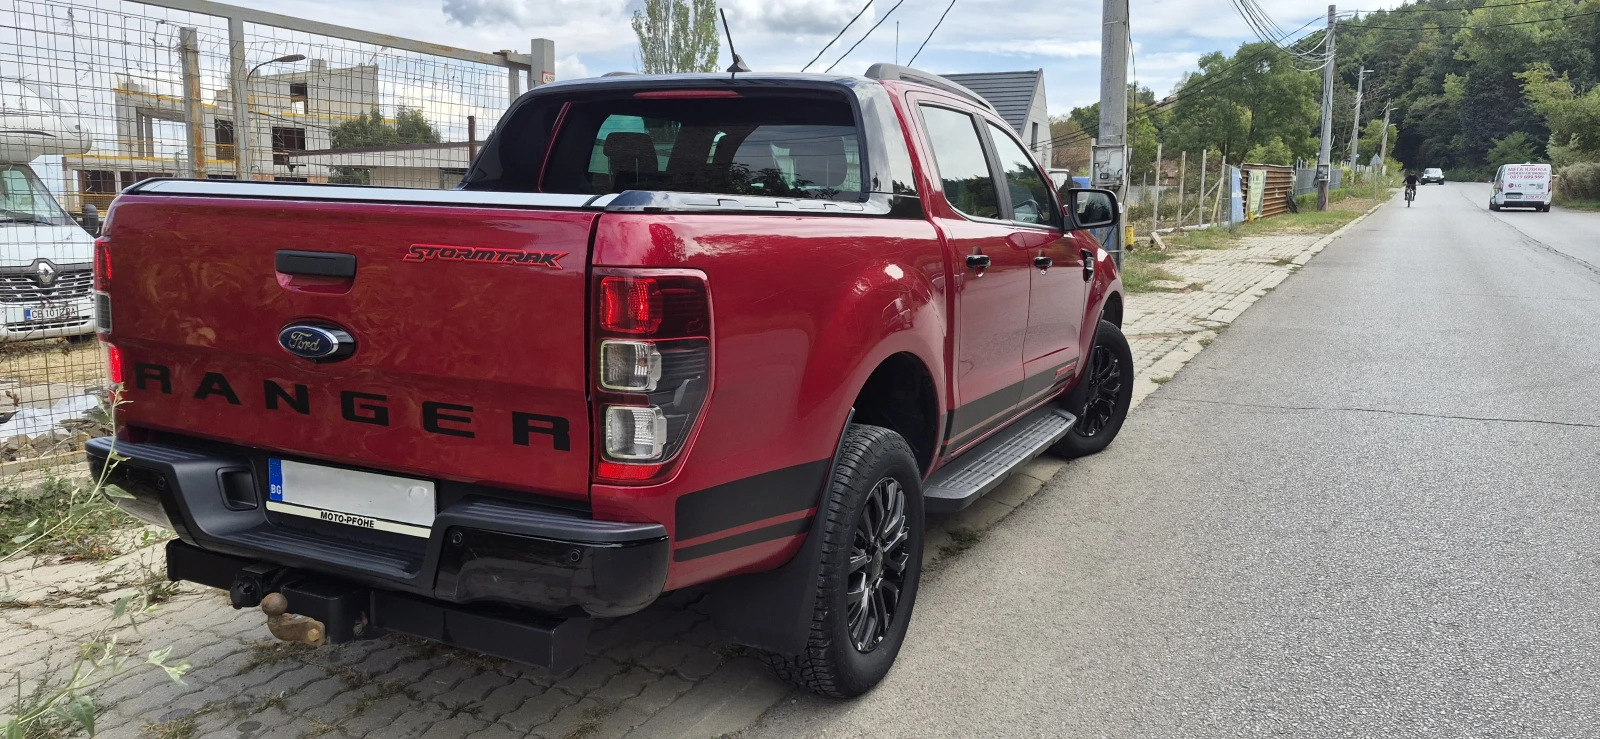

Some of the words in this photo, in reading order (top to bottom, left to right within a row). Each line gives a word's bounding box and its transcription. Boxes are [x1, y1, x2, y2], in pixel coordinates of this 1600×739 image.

[403, 244, 566, 269] STORMTRAK
[289, 331, 320, 351] Ford
[134, 361, 571, 452] RANGER
[270, 484, 282, 495] BG
[320, 511, 374, 529] MOTO-PFOHE
